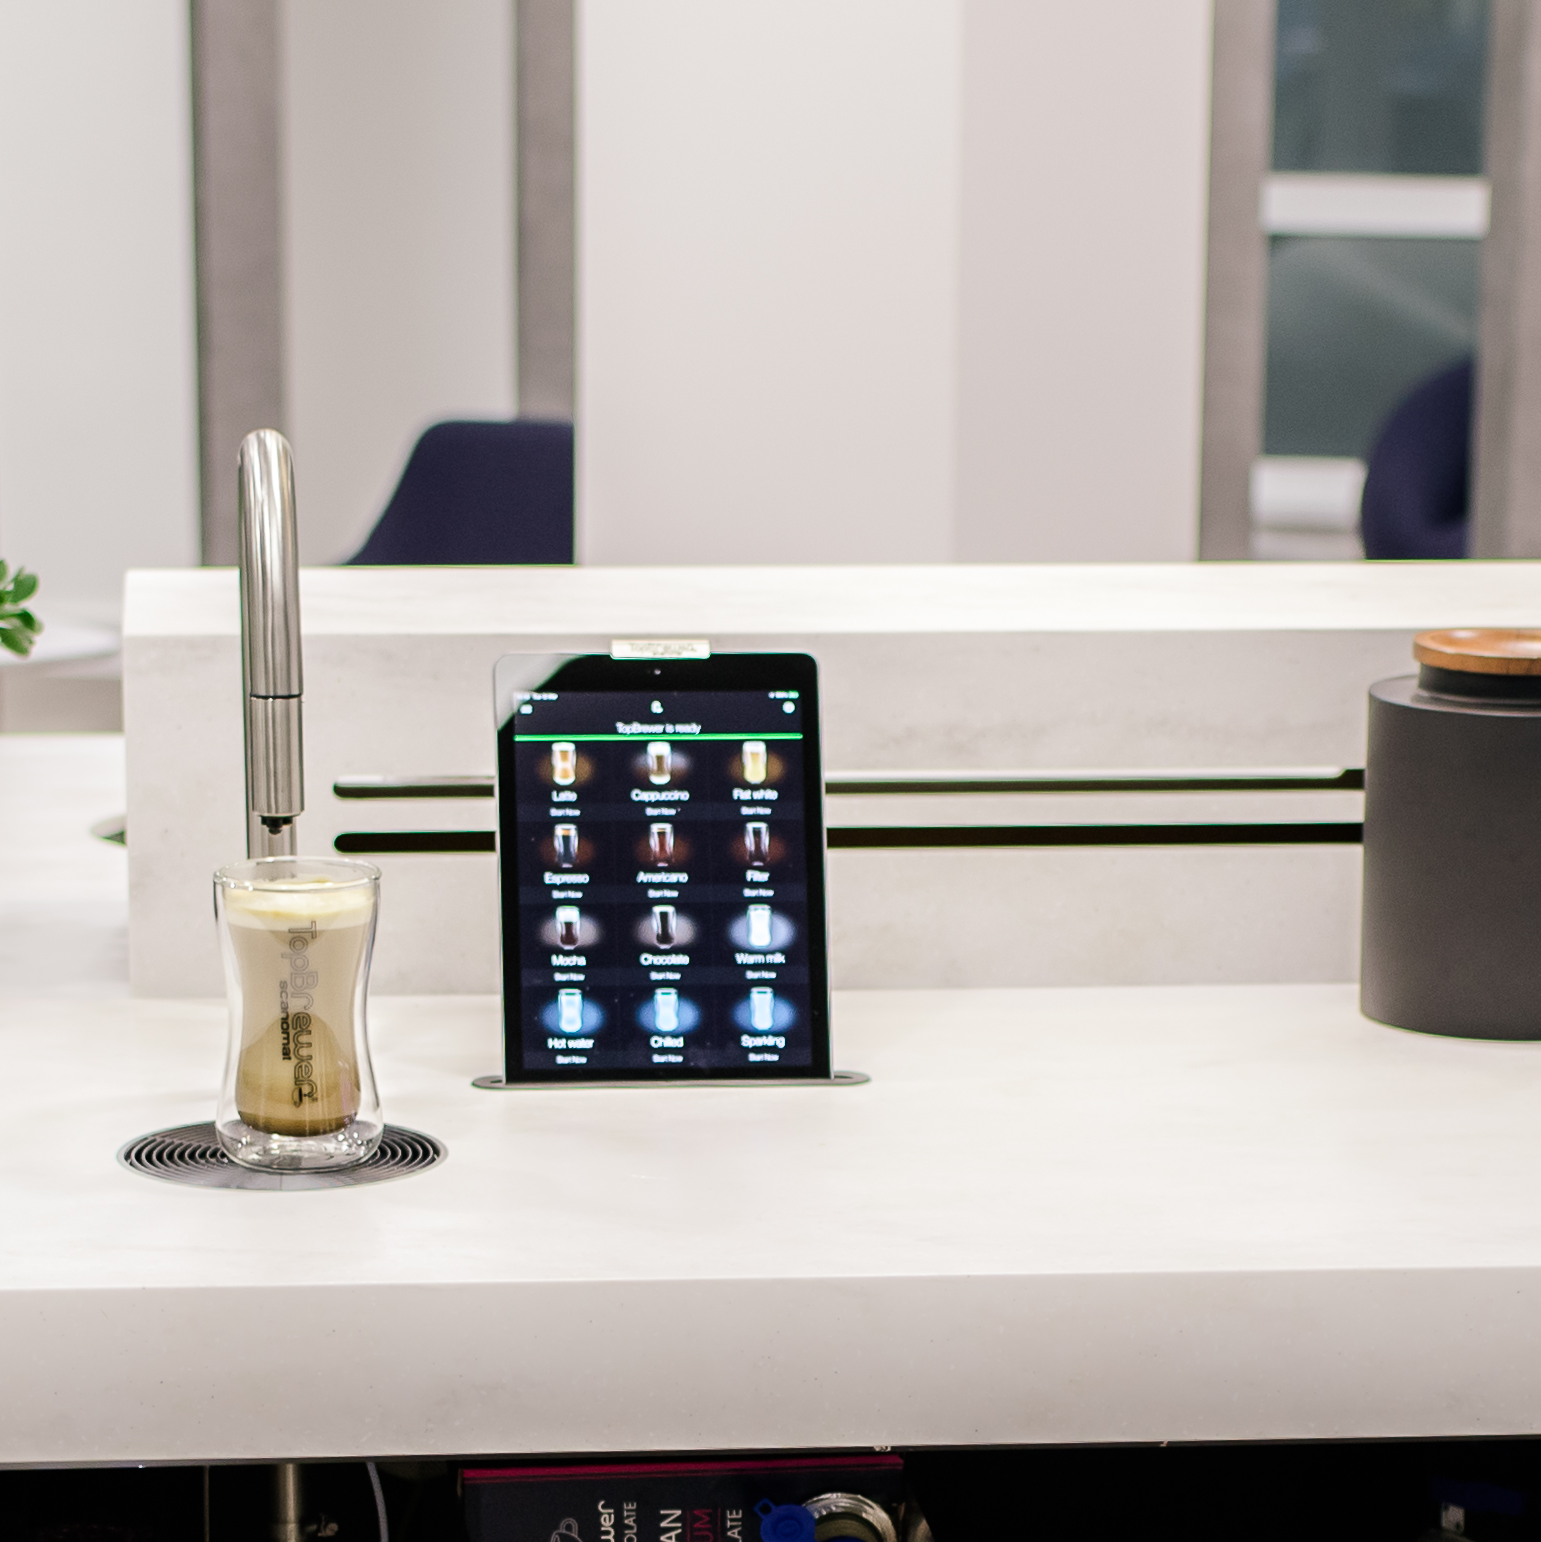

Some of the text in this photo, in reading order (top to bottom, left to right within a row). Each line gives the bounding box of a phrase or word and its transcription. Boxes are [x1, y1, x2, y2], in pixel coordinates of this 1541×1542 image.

[616, 721, 665, 735] TopBrewer
[674, 723, 702, 736] ready
[630, 789, 690, 803] Cappuccino
[732, 788, 778, 801] Flat white
[543, 871, 590, 886] Espresso
[636, 871, 688, 884] Americano
[551, 954, 586, 967] Mocha
[639, 952, 690, 966] Chocolate
[735, 952, 786, 965] Warm milk
[281, 920, 318, 1103] TopBrewer
[279, 980, 292, 1062] scanomat
[548, 1037, 594, 1050] Hot water
[650, 1035, 684, 1048] Chilled
[741, 1035, 786, 1049] Sparkling
